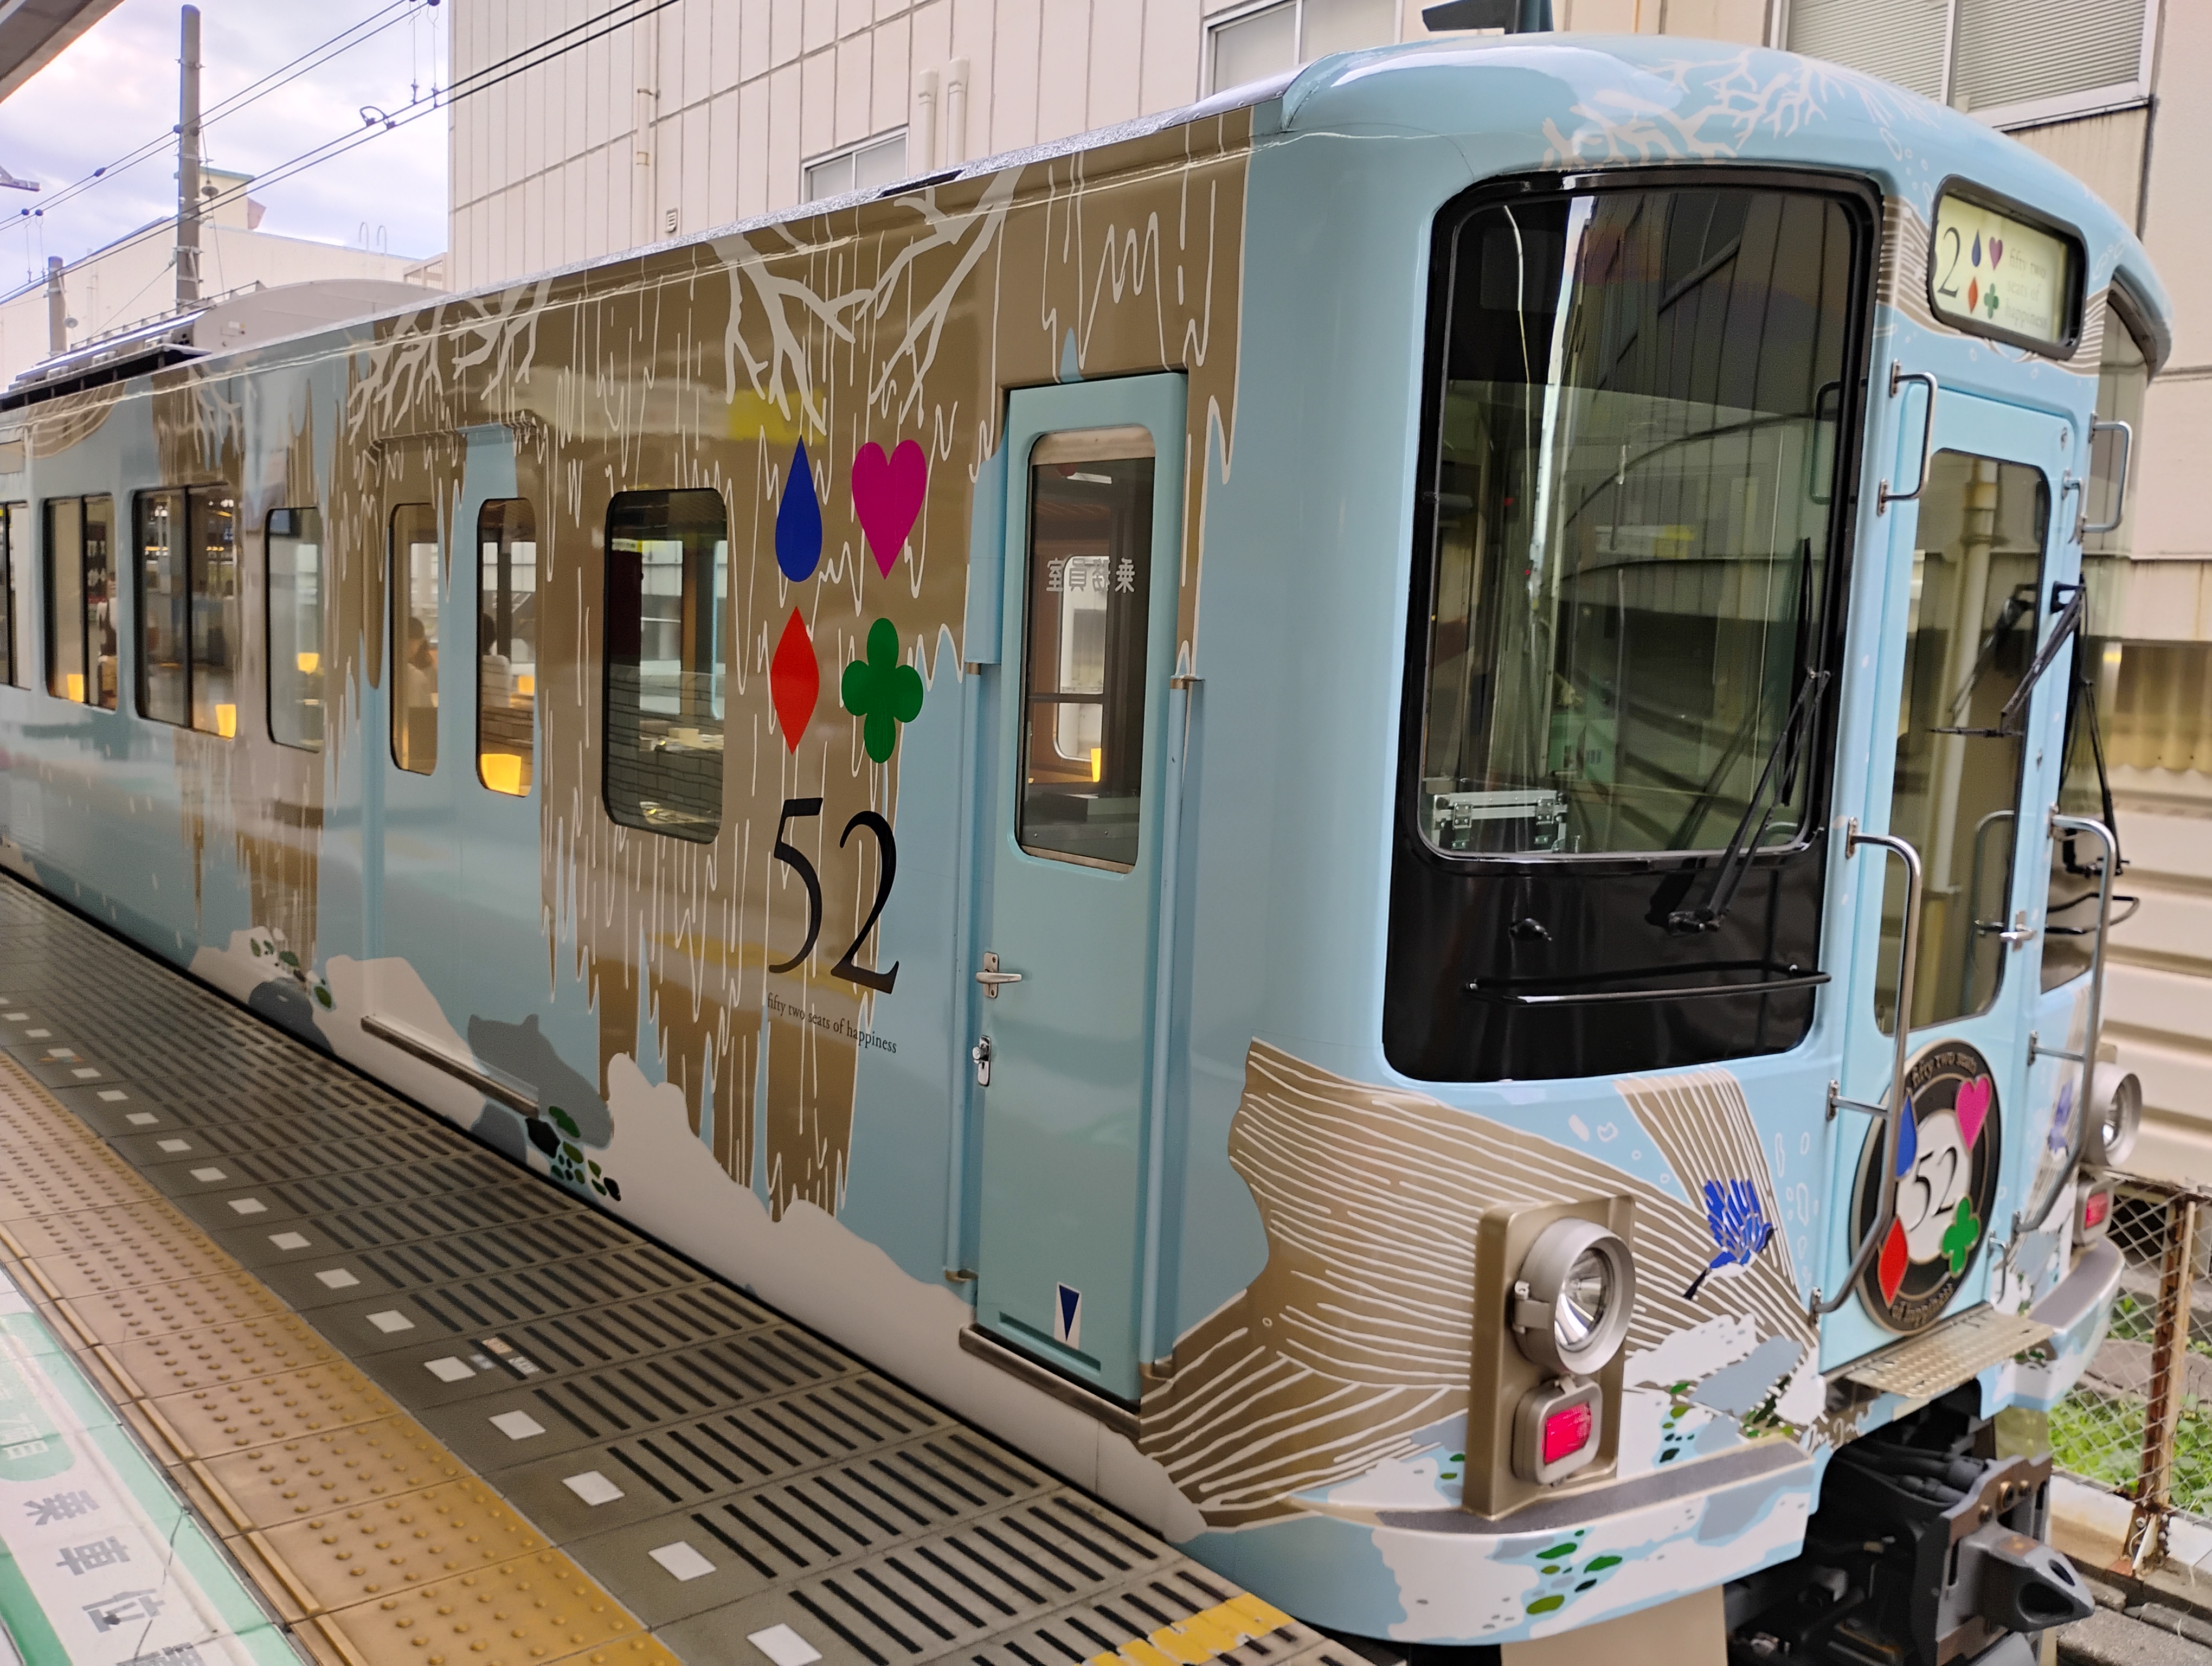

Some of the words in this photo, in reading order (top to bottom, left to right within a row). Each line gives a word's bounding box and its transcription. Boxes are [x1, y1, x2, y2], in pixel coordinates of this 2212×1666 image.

[769, 797, 899, 994] 52
[768, 992, 786, 1016] fifty
[789, 1005, 805, 1020] two
[808, 1013, 830, 1029] seats
[833, 1018, 845, 1034] of
[847, 1021, 897, 1053] happiness
[1908, 1146, 1958, 1232] 52
